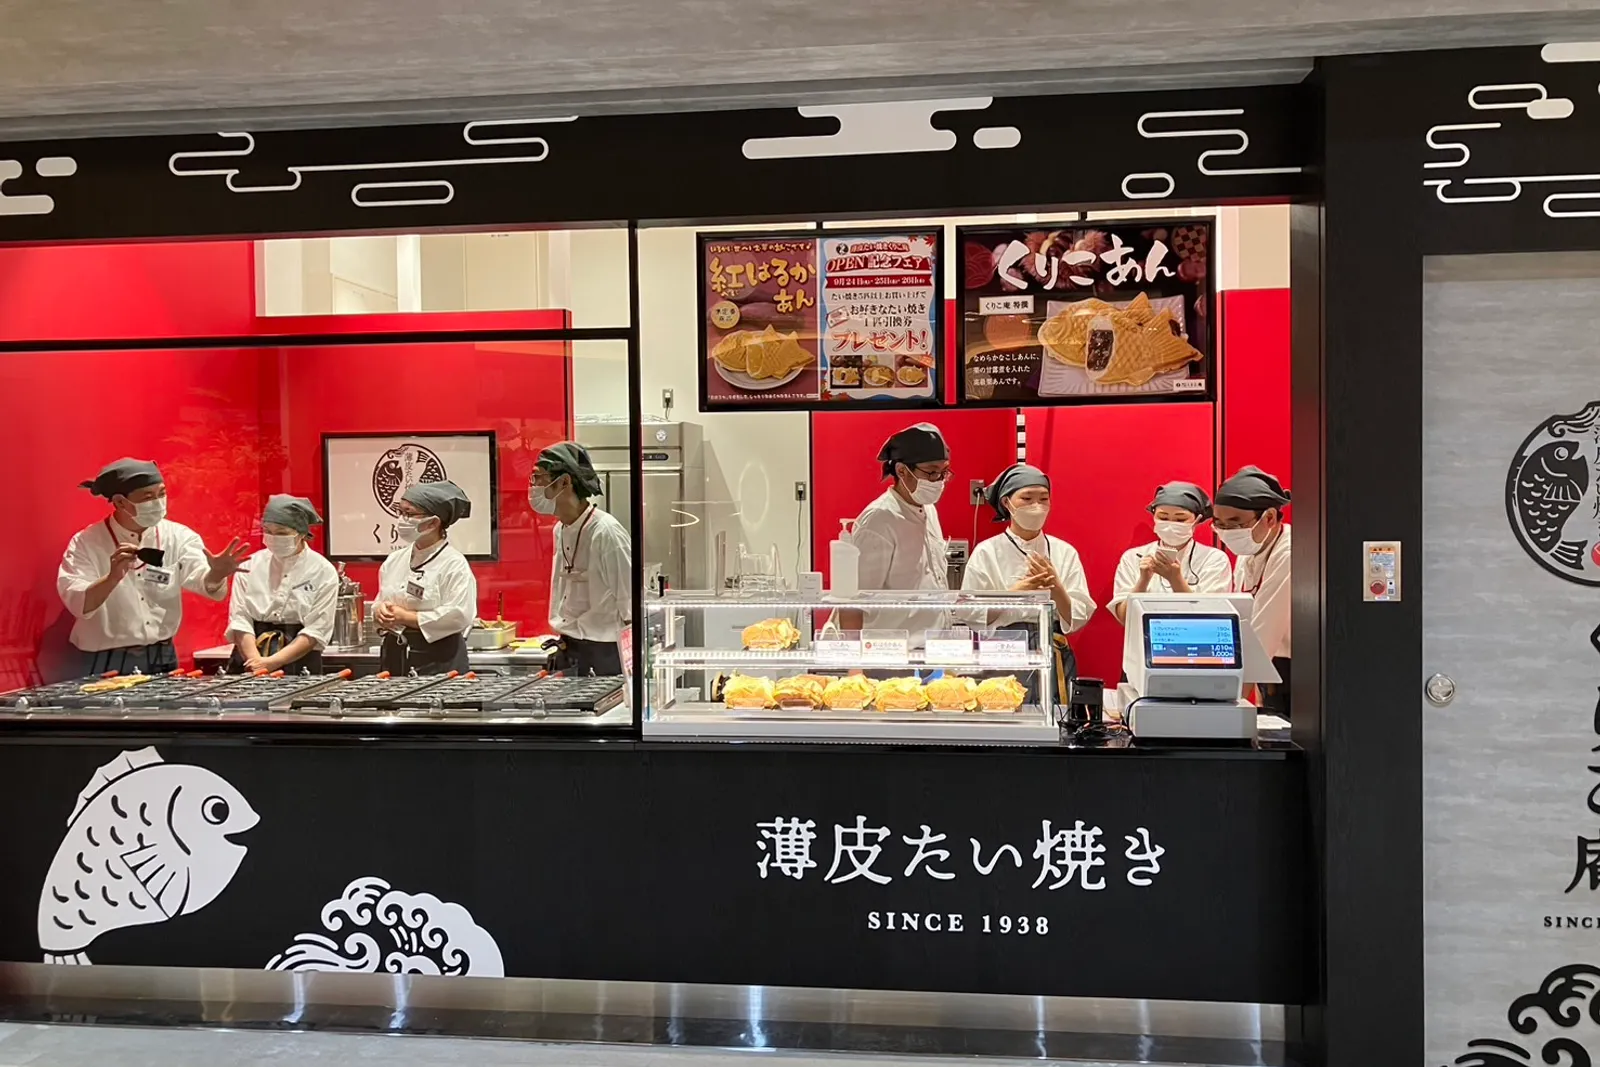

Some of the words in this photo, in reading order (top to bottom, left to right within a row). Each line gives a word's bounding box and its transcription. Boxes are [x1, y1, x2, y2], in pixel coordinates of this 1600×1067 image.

[709, 256, 816, 292] 紅はるか
[826, 255, 865, 271] OPEN
[998, 234, 1176, 290] くりこあん
[773, 288, 814, 313] あん
[850, 303, 926, 315] お好きなたい焼き
[832, 329, 929, 351] プレゼント!
[373, 523, 399, 543] くり
[757, 815, 1166, 890] 薄皮たい焼き
[868, 911, 964, 932] SINCE
[982, 914, 1049, 935] 1938
